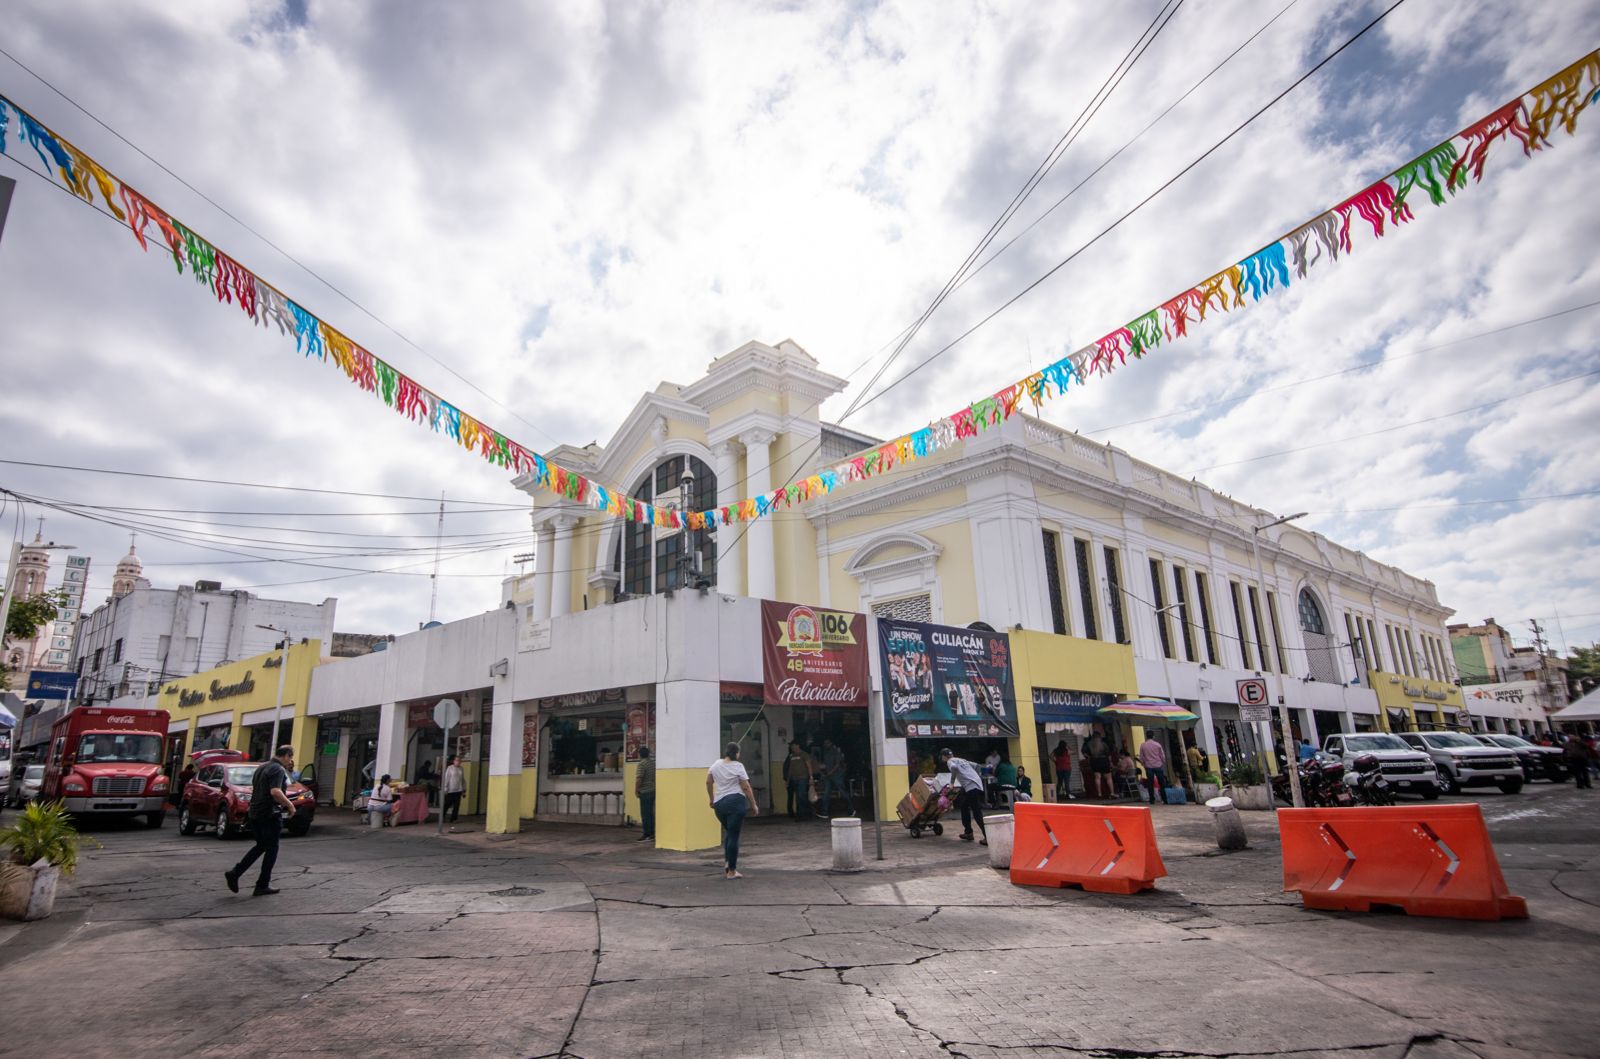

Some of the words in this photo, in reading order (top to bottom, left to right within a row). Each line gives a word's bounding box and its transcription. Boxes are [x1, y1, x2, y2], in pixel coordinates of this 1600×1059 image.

[821, 614, 848, 634] 106
[901, 632, 922, 641] SHOW
[931, 632, 984, 650] CULIACÁN
[1246, 684, 1259, 700] E
[1495, 689, 1523, 697] IMPORT
